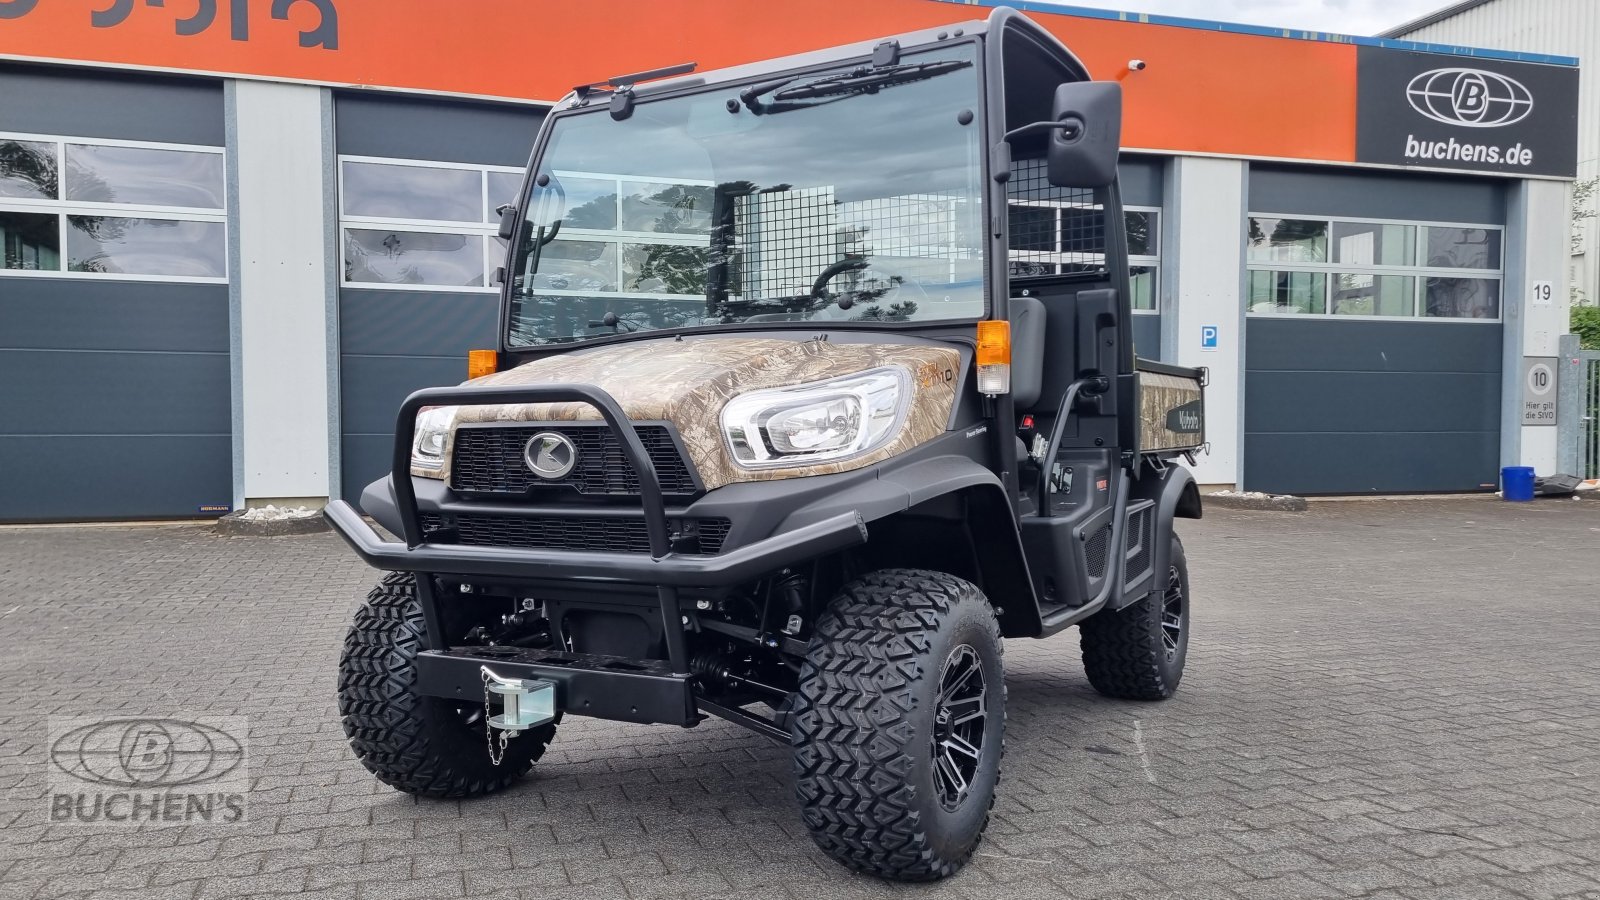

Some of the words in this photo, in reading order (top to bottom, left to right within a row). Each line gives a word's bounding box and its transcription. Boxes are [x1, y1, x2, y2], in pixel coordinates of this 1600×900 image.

[1404, 134, 1533, 166] buchens.de
[1534, 284, 1551, 301] 19
[1203, 328, 1215, 346] P
[1534, 371, 1547, 387] 10
[1525, 401, 1540, 410] Hier
[1542, 401, 1554, 411] gilt
[1525, 411, 1536, 419] die
[1537, 411, 1554, 419] StVO
